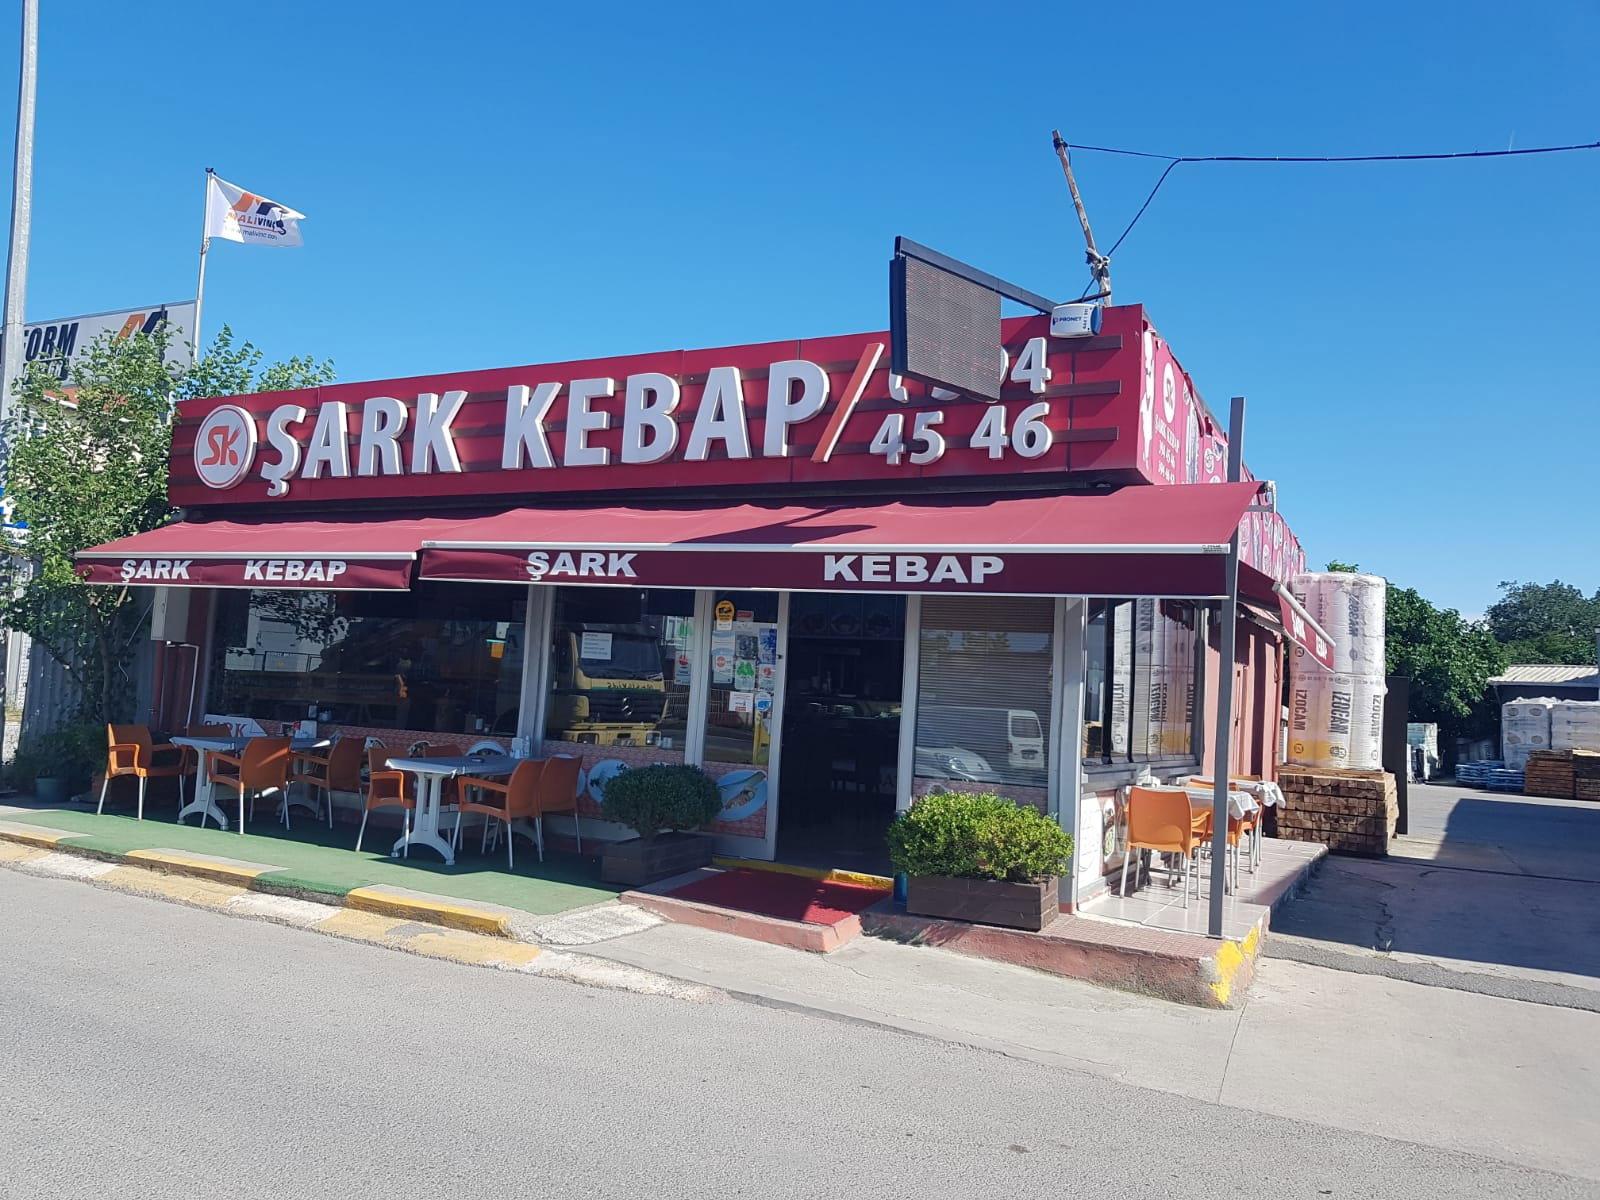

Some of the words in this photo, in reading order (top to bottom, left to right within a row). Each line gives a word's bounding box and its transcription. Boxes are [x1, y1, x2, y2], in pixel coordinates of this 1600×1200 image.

[260, 390, 469, 498] ŞARK
[501, 359, 831, 471] KEBAP
[869, 410, 946, 466] 45
[969, 401, 1053, 459] 46
[120, 560, 194, 583] ŞARK
[243, 560, 347, 582] KEBAP
[526, 552, 639, 581] ŞARK
[823, 554, 1005, 584] KEBAP
